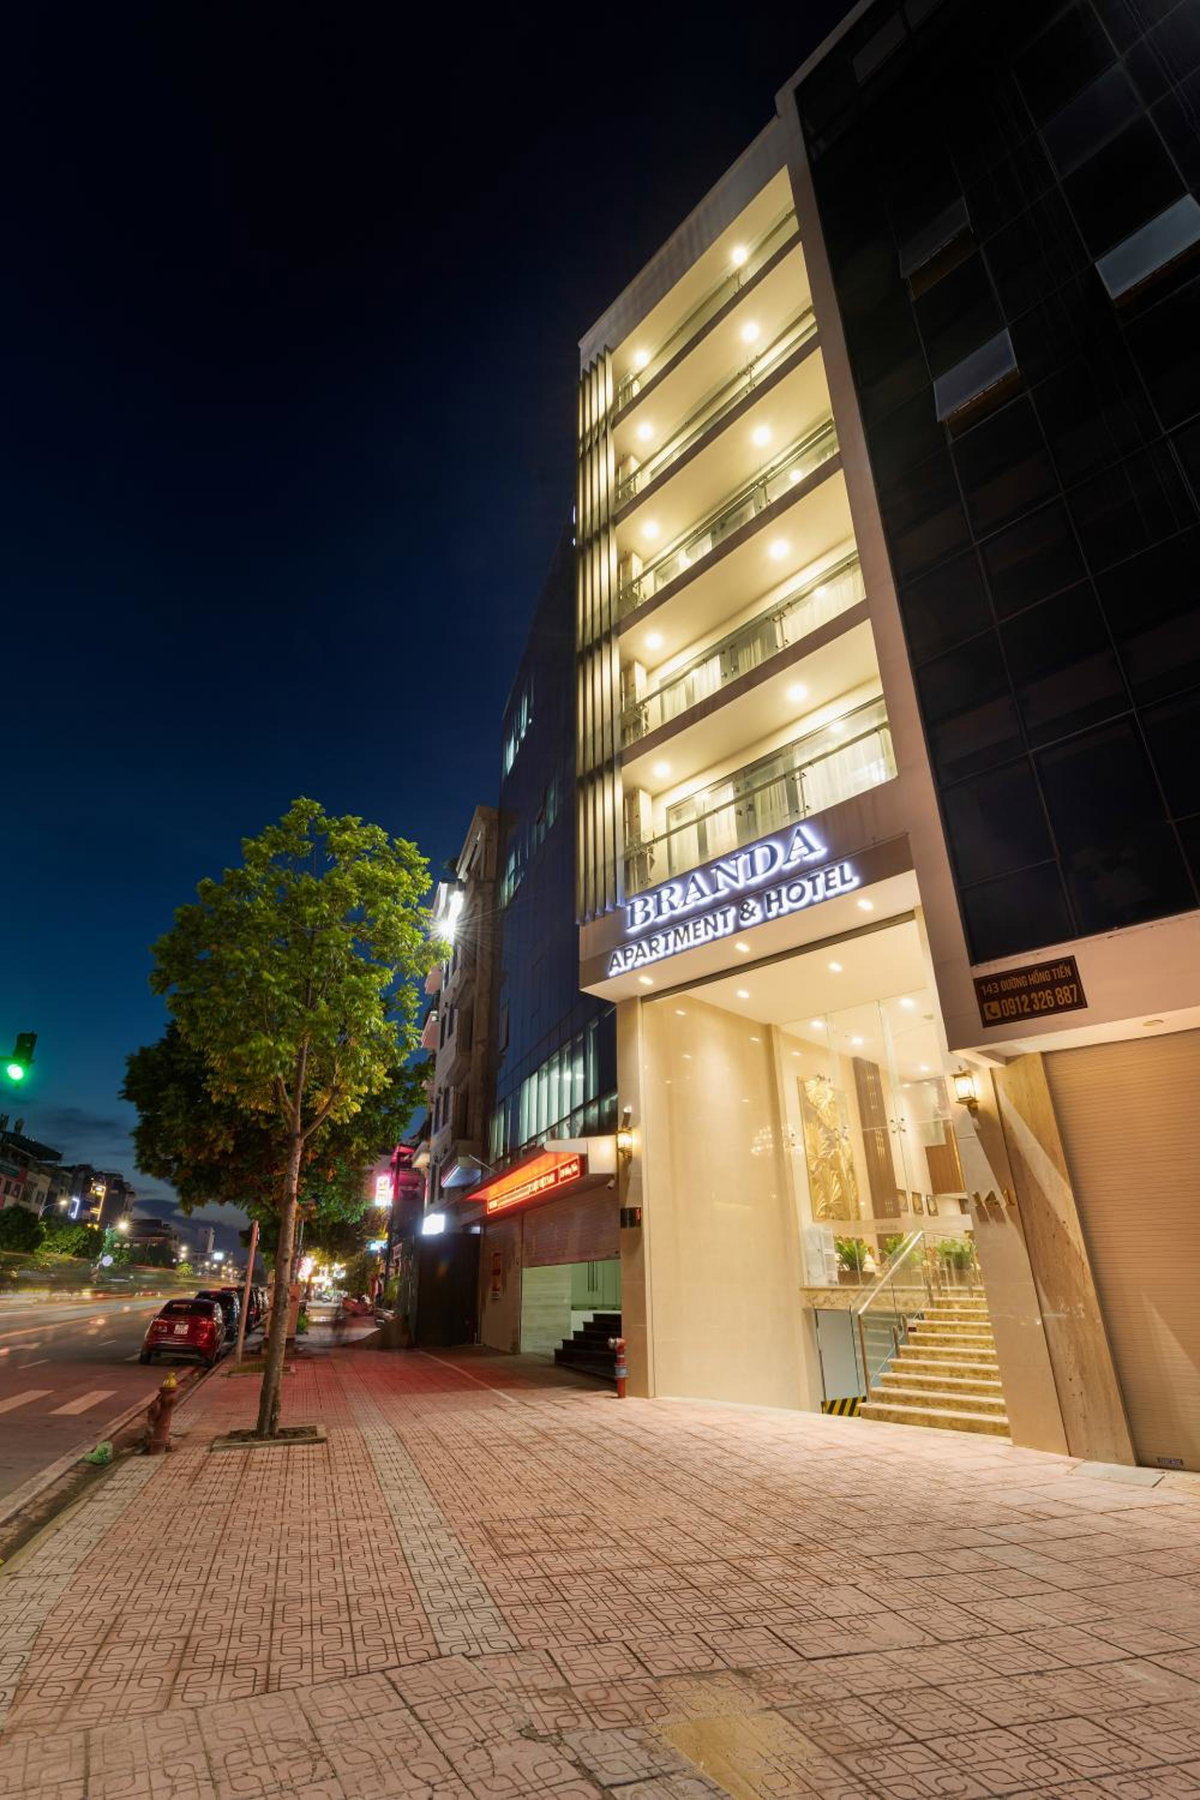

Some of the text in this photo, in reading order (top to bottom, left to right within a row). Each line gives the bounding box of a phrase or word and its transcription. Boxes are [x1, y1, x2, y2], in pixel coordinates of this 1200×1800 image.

[609, 863, 859, 974] APARTMENT & HOTEL
[627, 826, 827, 931] BRANDA
[1001, 984, 1077, 1017] 0912 326 887
